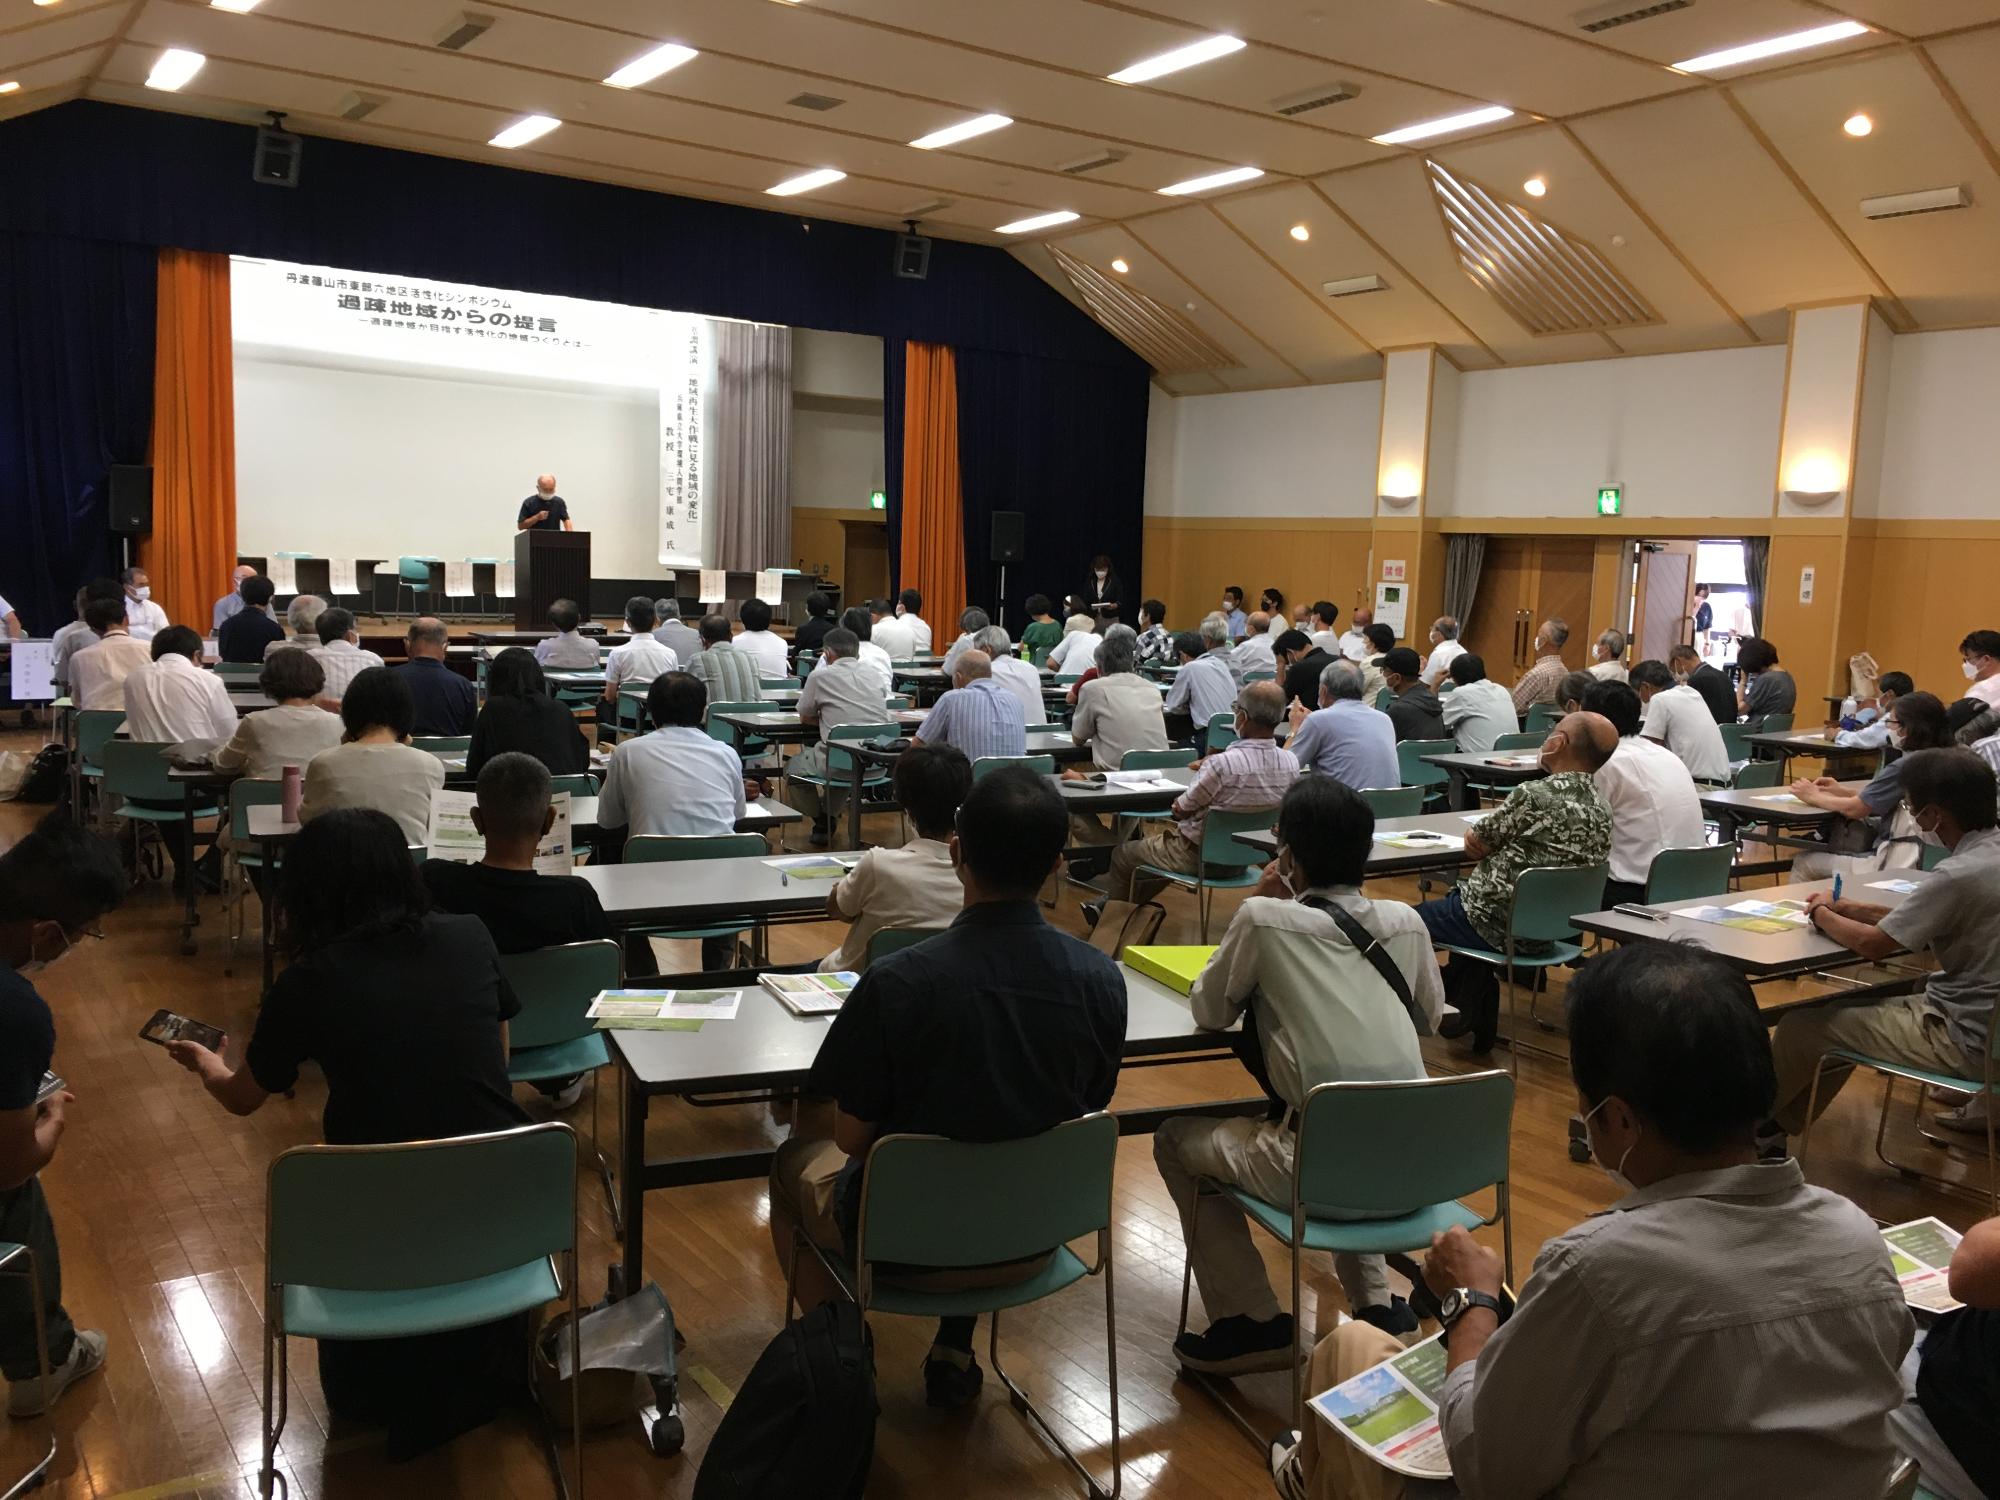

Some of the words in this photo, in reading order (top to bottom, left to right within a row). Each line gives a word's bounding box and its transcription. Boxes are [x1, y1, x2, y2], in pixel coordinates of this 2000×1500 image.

[337, 294, 558, 333] 過疎地域からの提言
